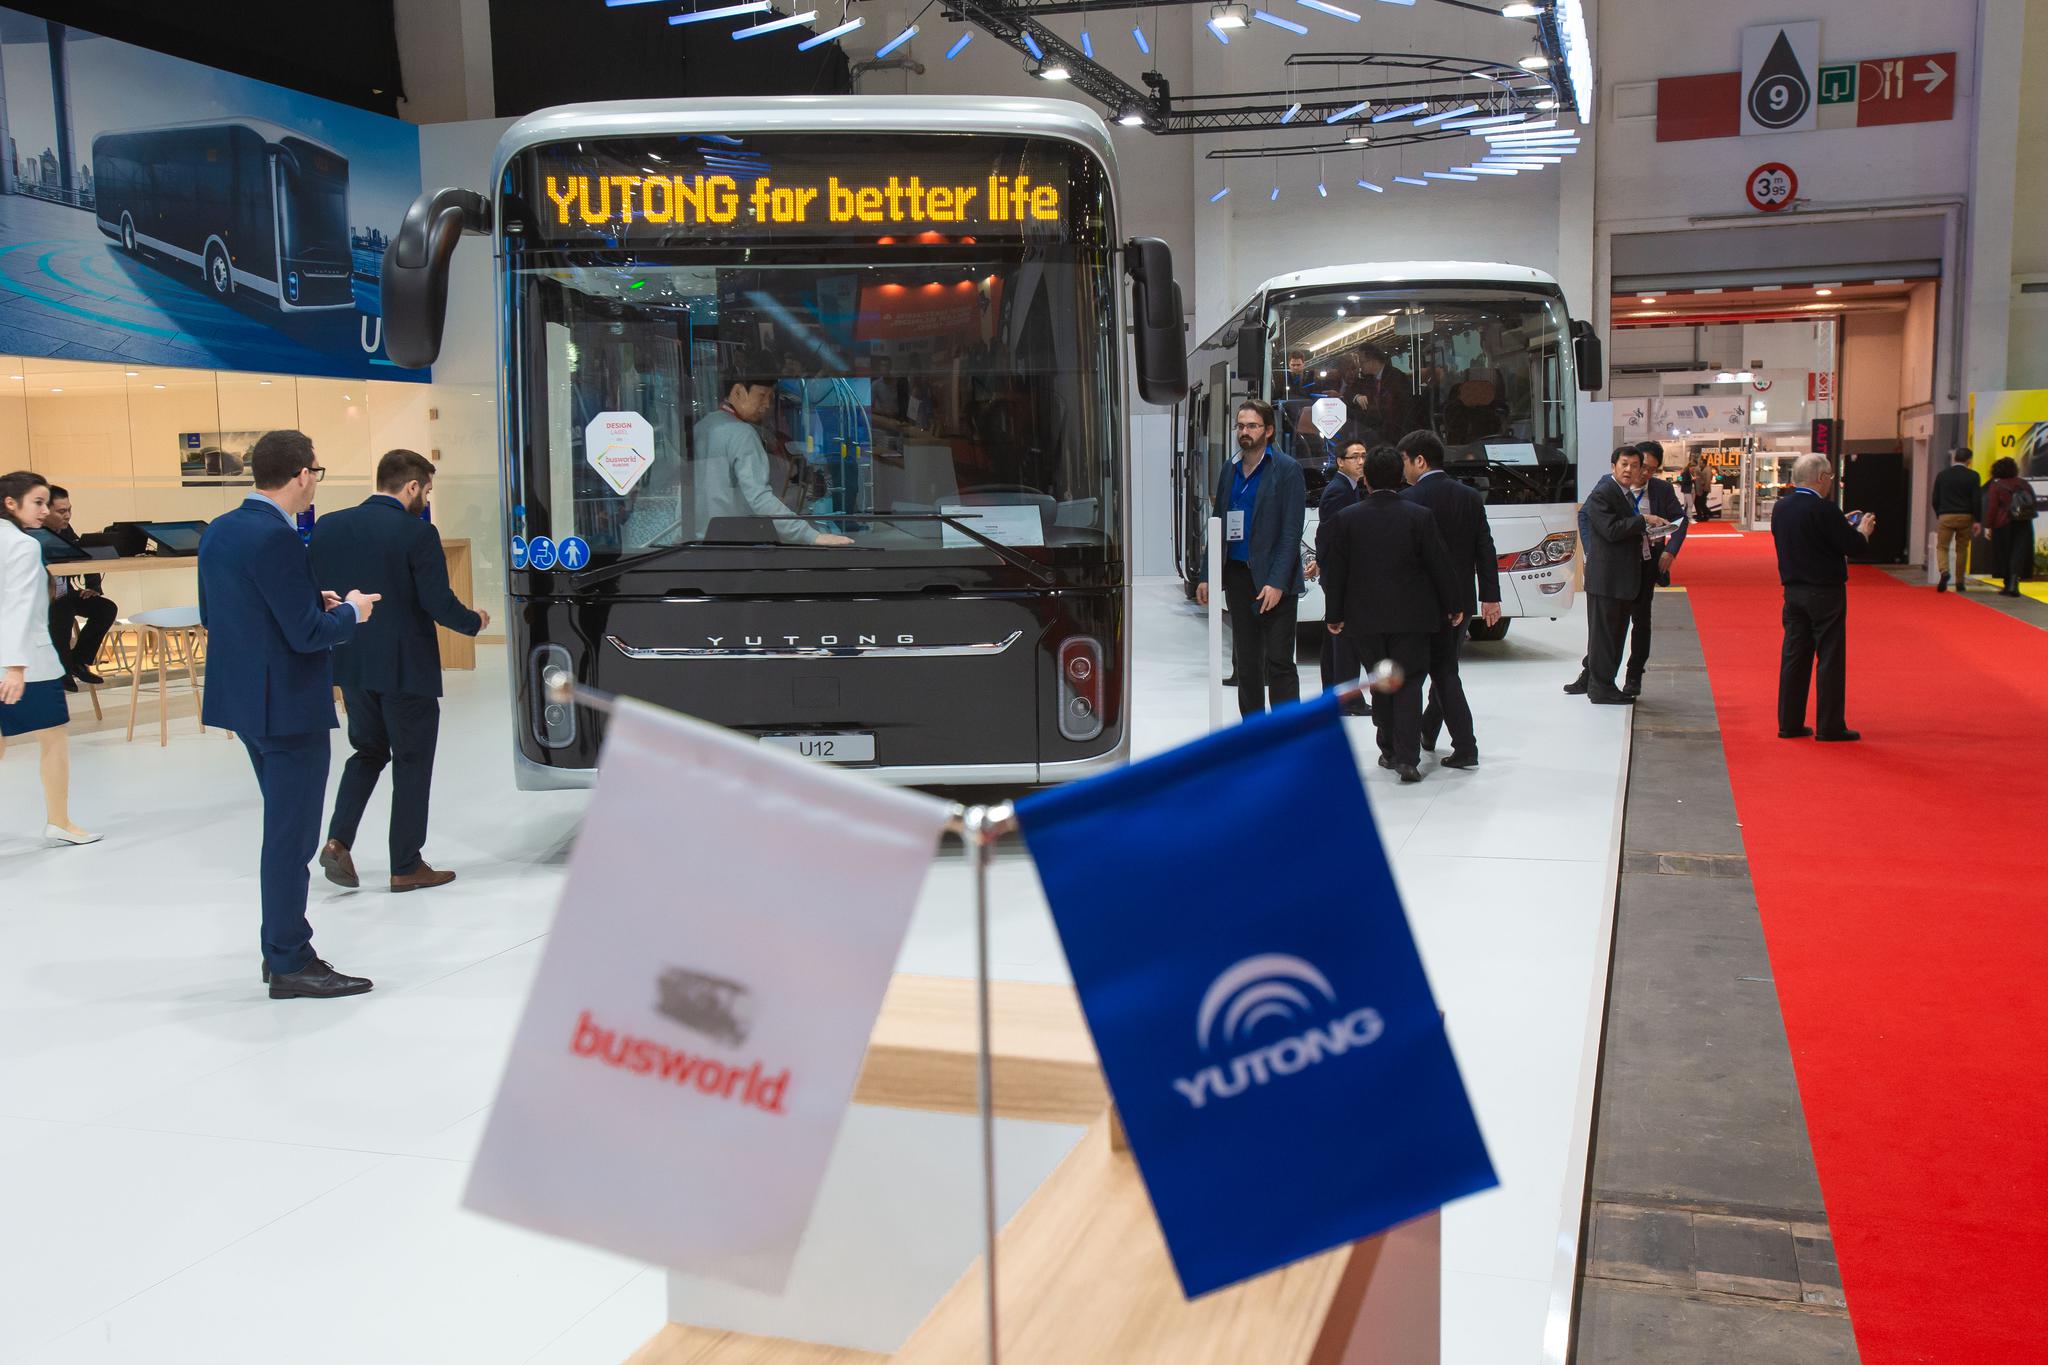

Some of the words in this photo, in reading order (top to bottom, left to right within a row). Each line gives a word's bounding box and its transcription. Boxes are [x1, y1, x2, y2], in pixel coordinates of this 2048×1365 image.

[1769, 85, 1789, 111] 9
[546, 176, 739, 224] YUTONG
[750, 177, 818, 222] for
[829, 176, 977, 222] better
[989, 175, 1058, 221] life
[1757, 178, 1771, 197] 3
[1772, 185, 1786, 196] 95
[707, 634, 914, 646] YUTONG
[799, 741, 834, 756] U12
[570, 1008, 790, 1117] busworld
[1173, 1006, 1384, 1108] YUTONG
